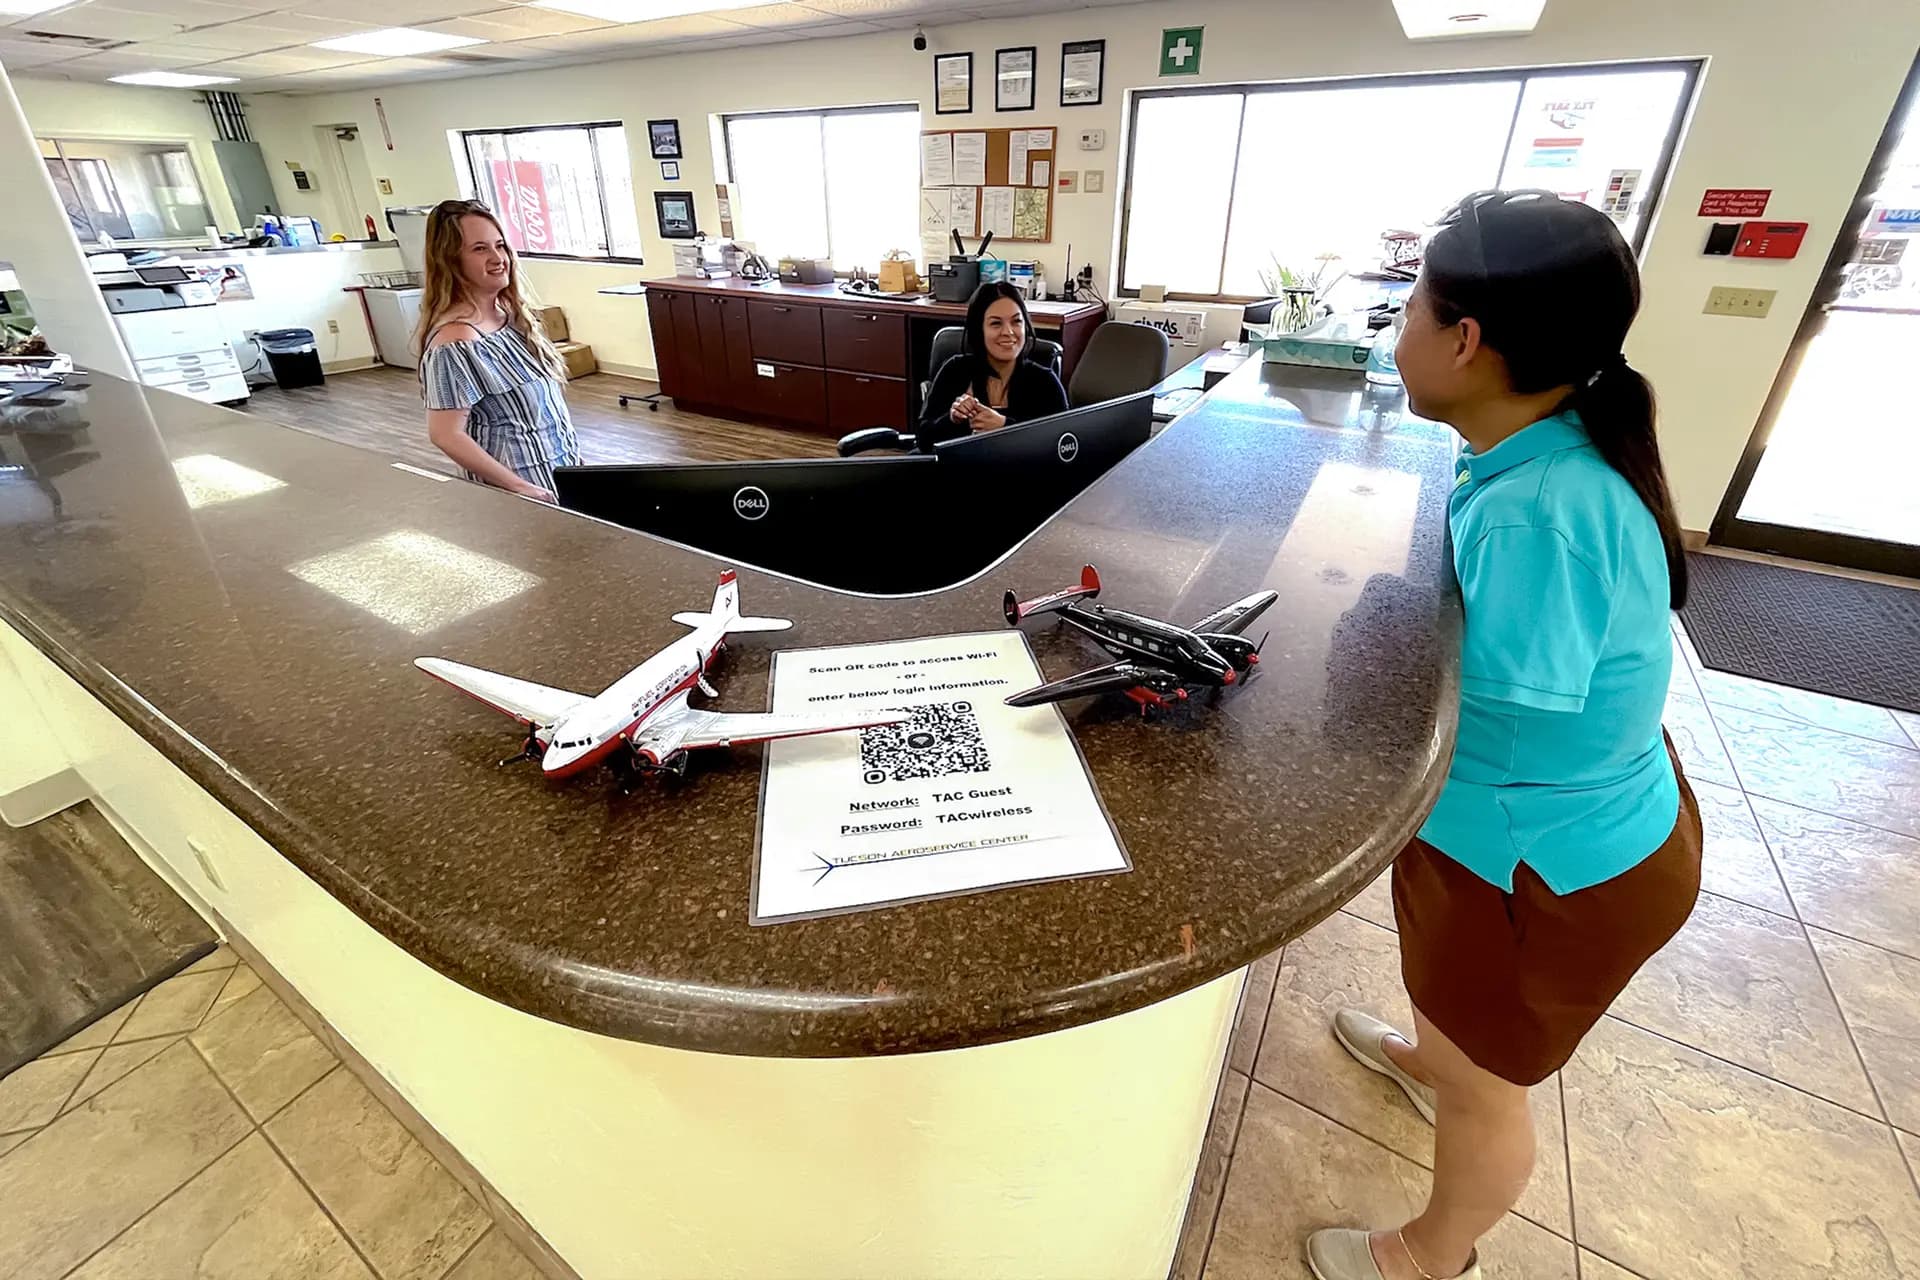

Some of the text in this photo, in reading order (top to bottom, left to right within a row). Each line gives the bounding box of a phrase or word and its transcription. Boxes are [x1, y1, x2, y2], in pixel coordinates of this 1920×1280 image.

[1061, 442, 1076, 453] DELL
[738, 499, 766, 509] DELL
[868, 661, 899, 669] code
[919, 655, 964, 665] access
[808, 678, 1009, 702] enter below login information.
[849, 786, 1013, 812] Network: TAC Guest
[840, 805, 1033, 835] Password: TACwireless
[832, 834, 1029, 864] TUCSON AEROSERVICE CENTER
